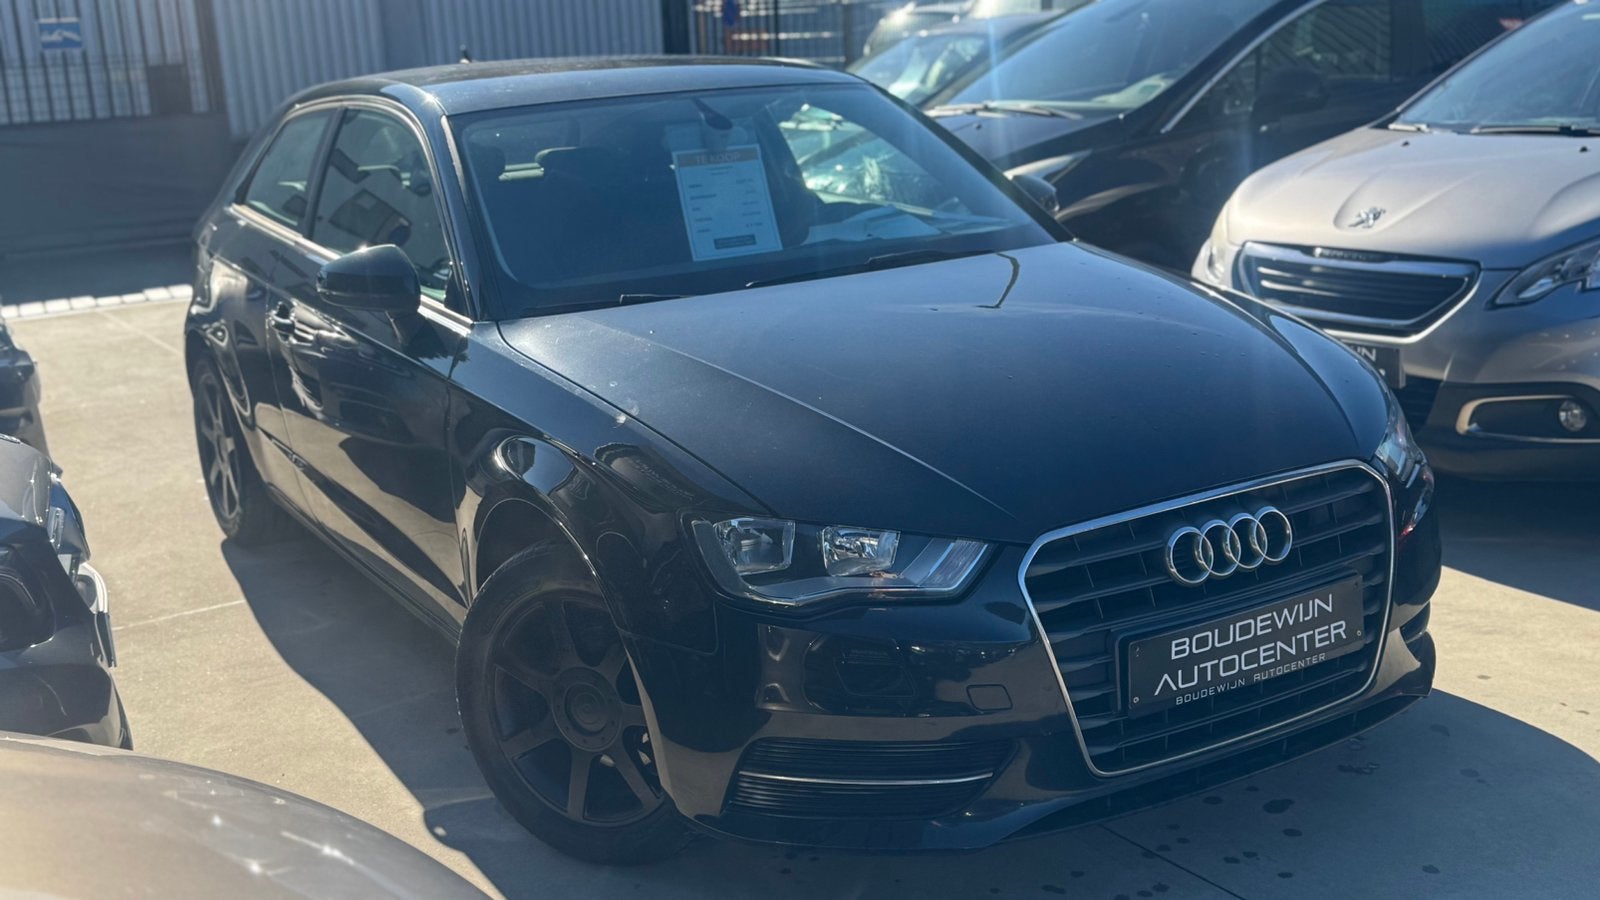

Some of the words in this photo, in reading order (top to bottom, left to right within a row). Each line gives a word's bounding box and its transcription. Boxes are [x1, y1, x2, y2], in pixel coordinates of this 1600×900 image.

[695, 154, 707, 165] TE
[709, 151, 741, 164] KOOP
[1170, 593, 1333, 660] BOUDEWIJN
[1153, 620, 1347, 696] AUTOCENTER
[1175, 678, 1246, 706] BOUDEWIJN
[1253, 652, 1327, 683] AUTOCENTER
